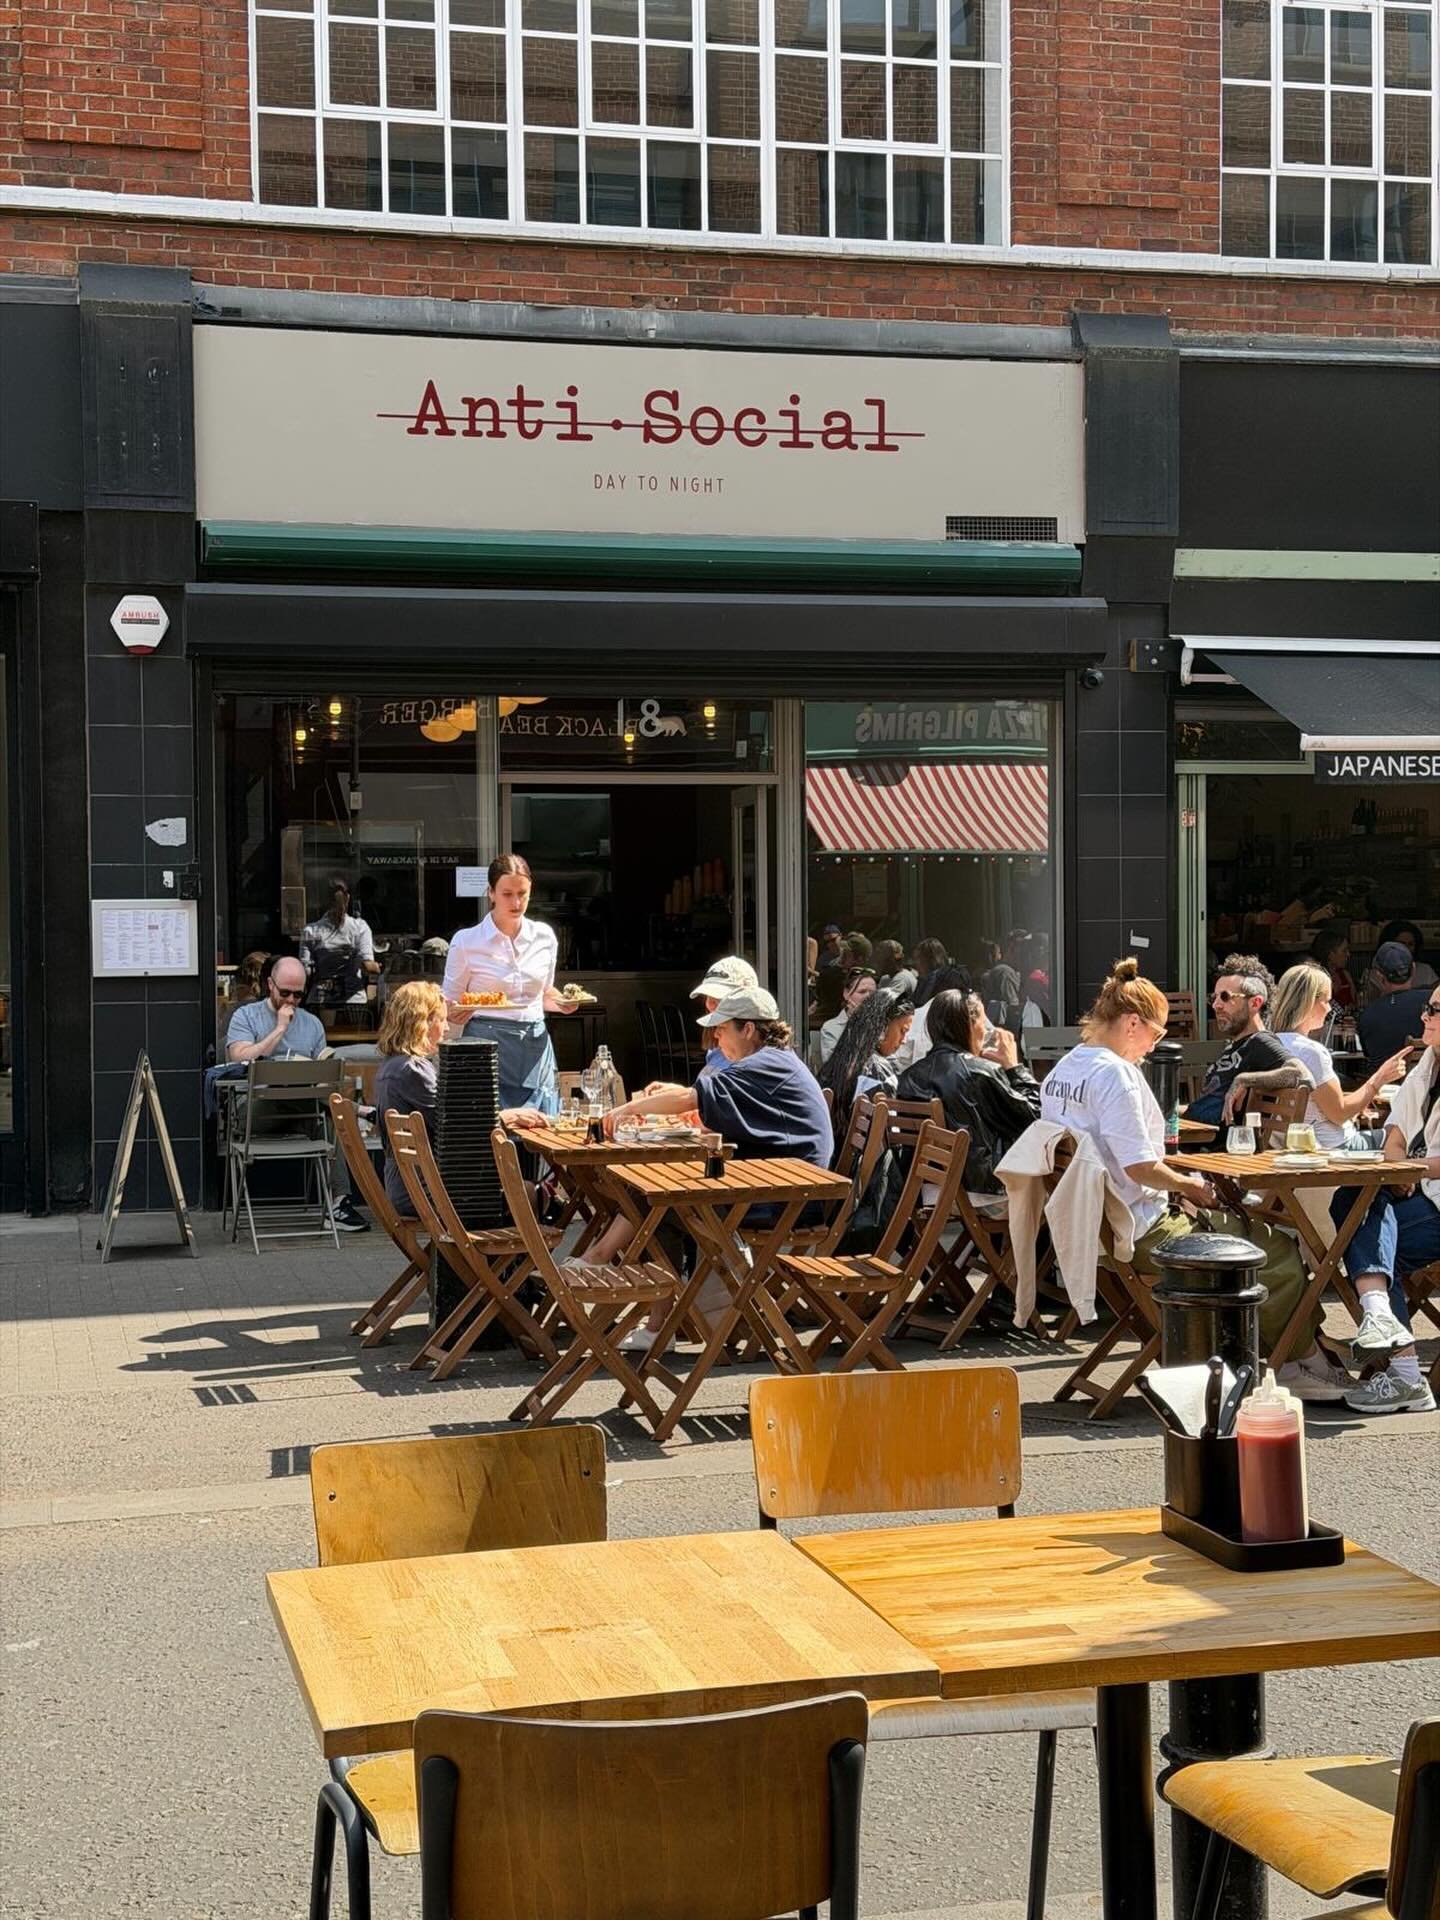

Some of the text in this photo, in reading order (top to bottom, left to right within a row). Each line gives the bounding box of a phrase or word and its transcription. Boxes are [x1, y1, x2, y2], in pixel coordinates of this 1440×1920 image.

[594, 474, 724, 493] DAY TO NIGHT
[1328, 755, 1440, 776] JAPANESE
